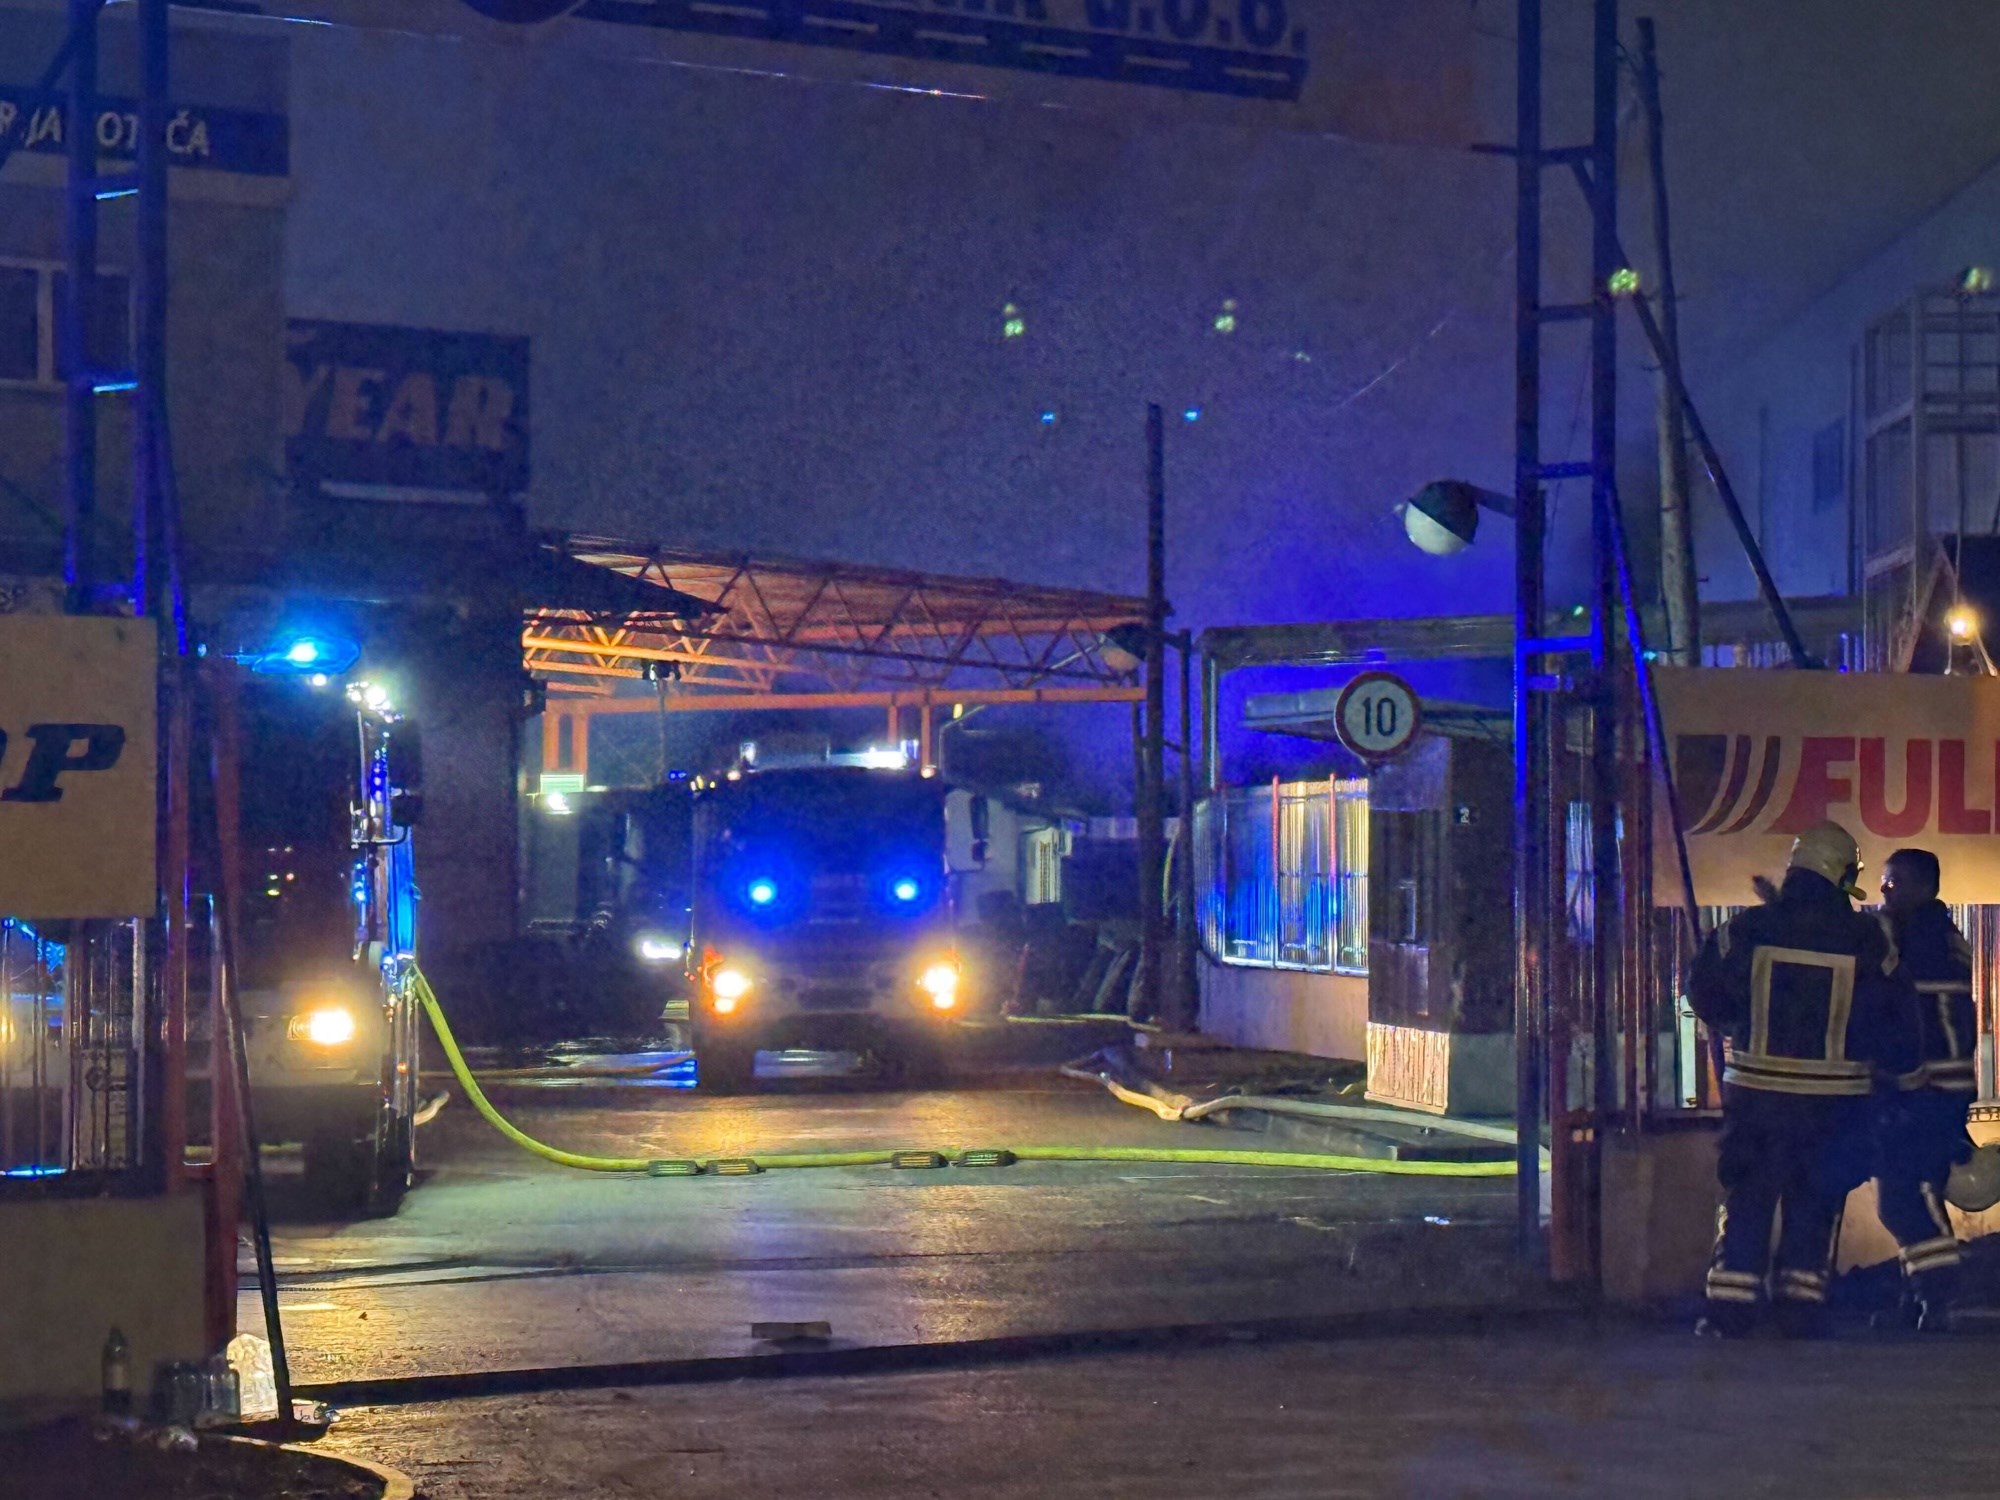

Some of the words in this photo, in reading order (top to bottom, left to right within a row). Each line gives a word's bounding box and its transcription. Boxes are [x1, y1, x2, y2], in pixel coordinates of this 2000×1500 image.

[96, 110, 210, 156] OTČA
[1362, 697, 1396, 736] 10
[0, 723, 126, 802] P
[1763, 736, 2000, 838] FUL
